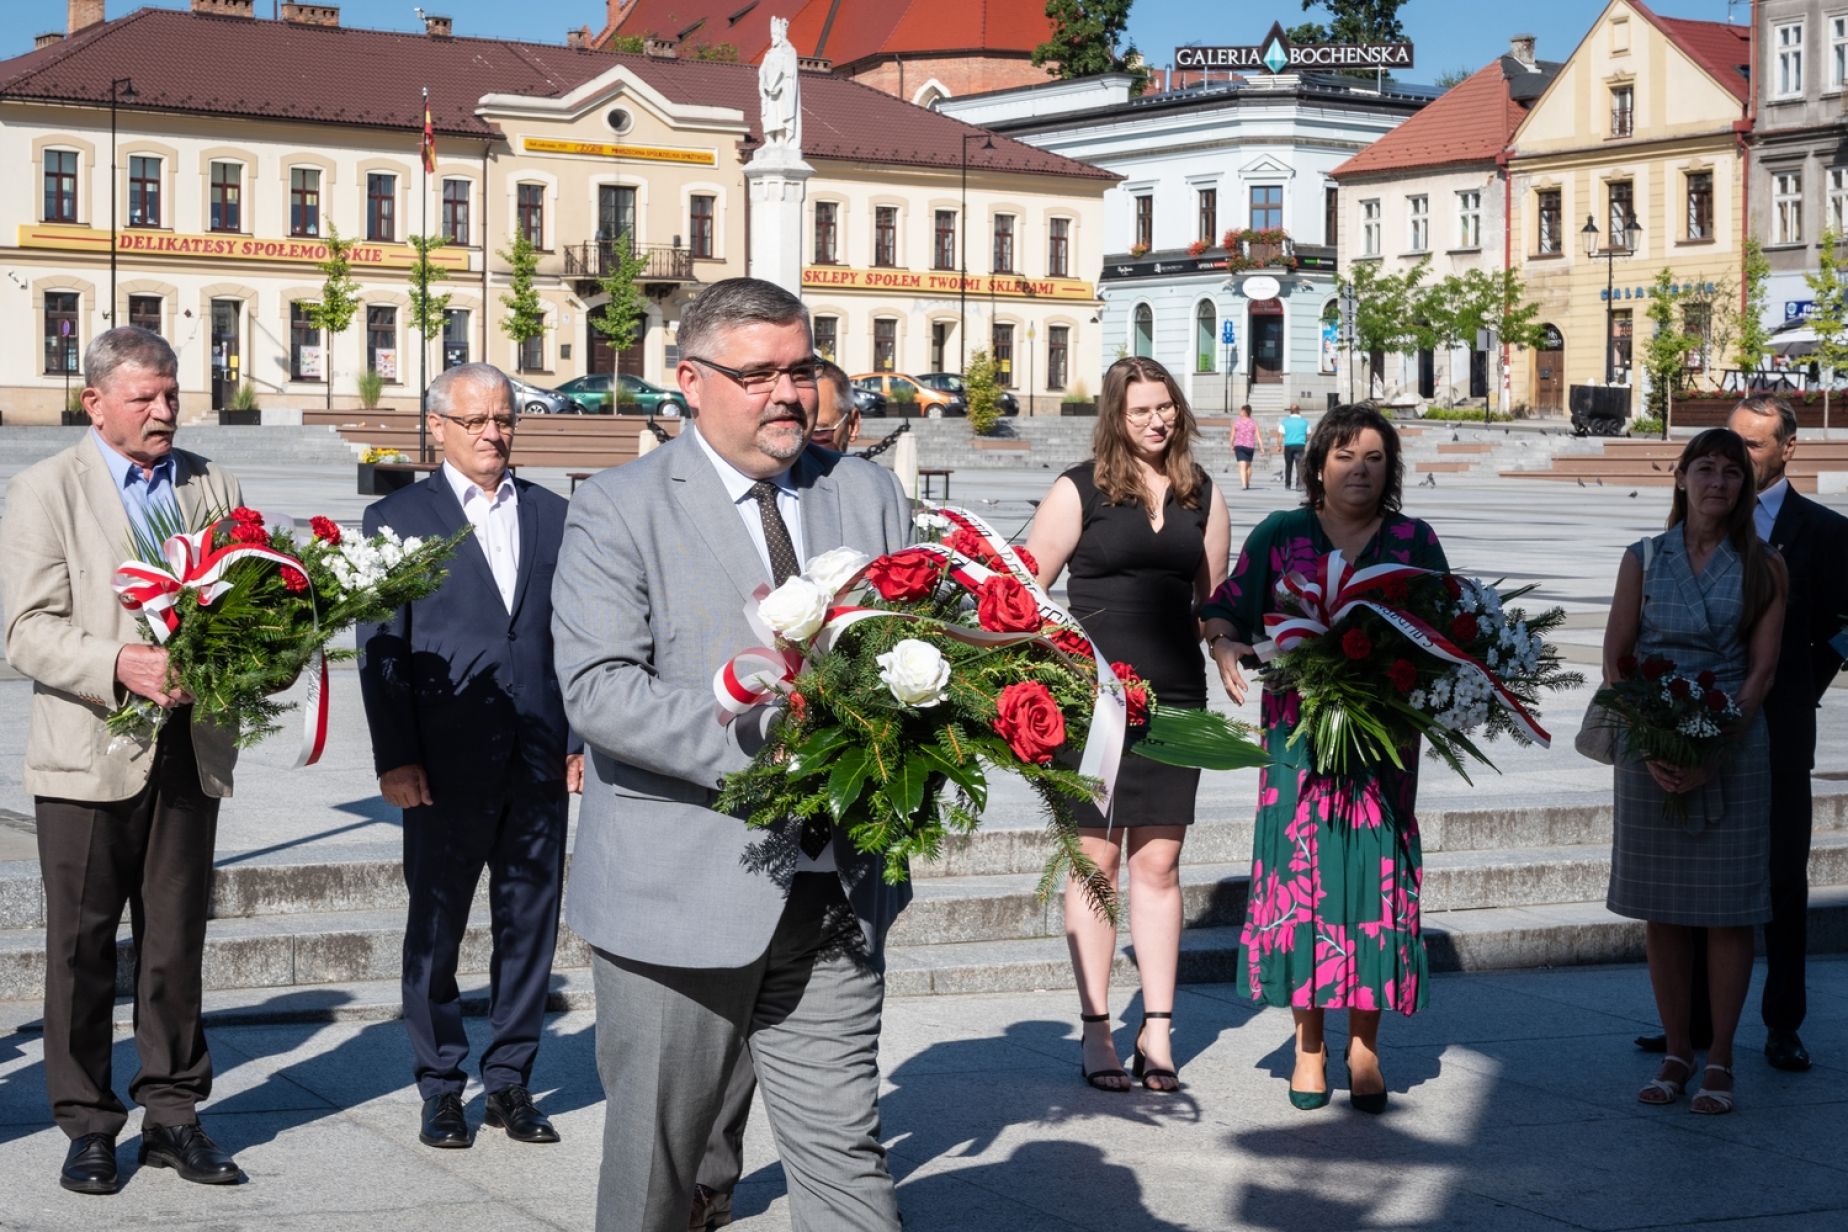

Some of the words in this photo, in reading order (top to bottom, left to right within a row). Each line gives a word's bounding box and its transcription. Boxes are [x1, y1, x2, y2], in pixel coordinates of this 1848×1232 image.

[1177, 48, 1262, 65] GALERIA
[1290, 43, 1410, 64] BOCHEŃSKA
[119, 235, 237, 254] DELIKATESY
[242, 241, 382, 262] SPOŁEMOSKIE
[803, 270, 858, 284] SKLEPY
[865, 272, 921, 287] SPOŁEM
[988, 279, 1055, 294] SKLEPAMI
